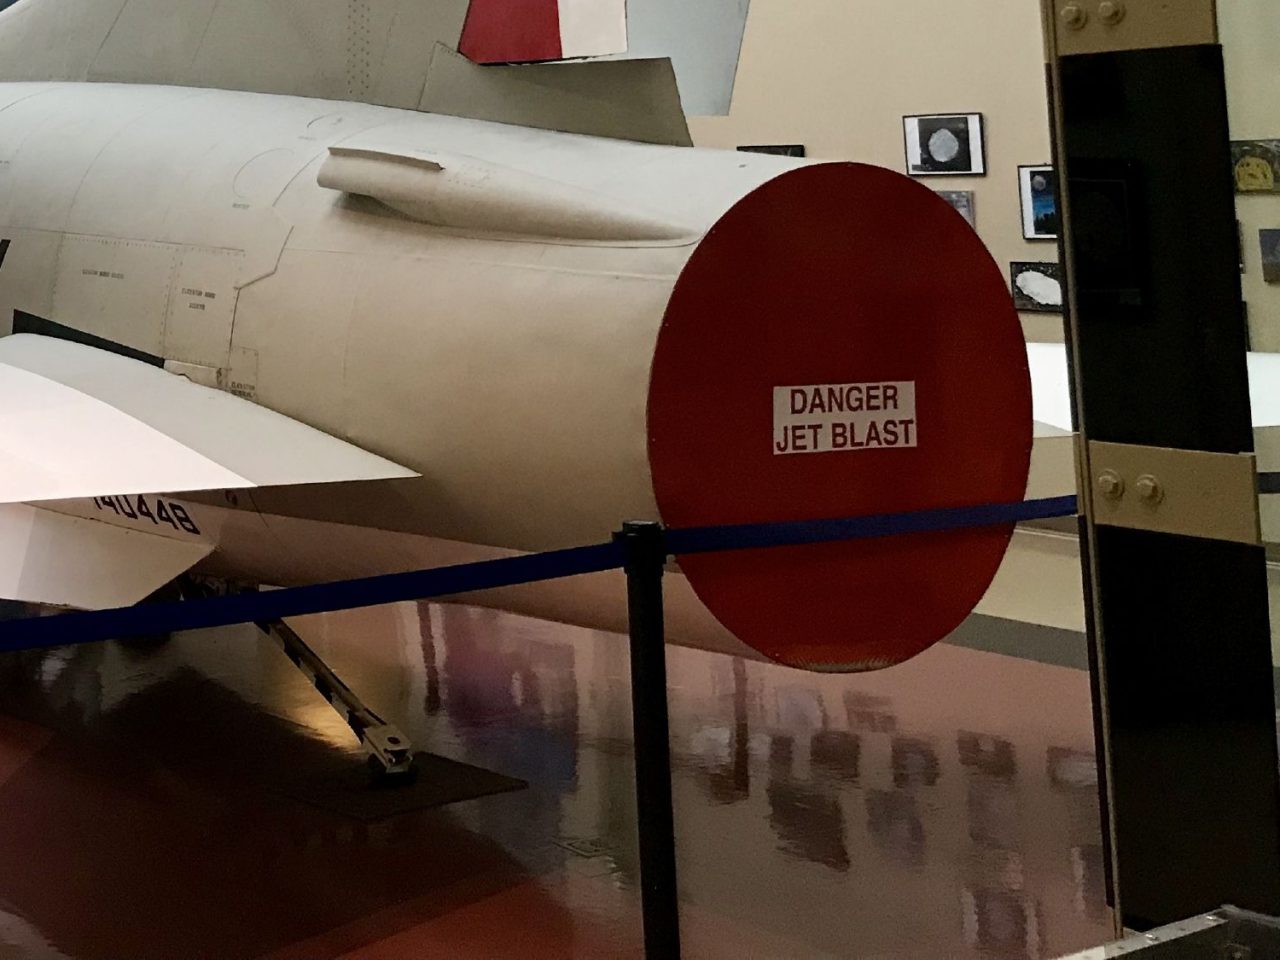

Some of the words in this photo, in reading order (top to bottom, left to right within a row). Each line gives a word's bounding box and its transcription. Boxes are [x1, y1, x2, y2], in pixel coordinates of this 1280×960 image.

[790, 385, 899, 415] DANGER
[776, 424, 823, 452] JET
[831, 419, 914, 448] BLAST
